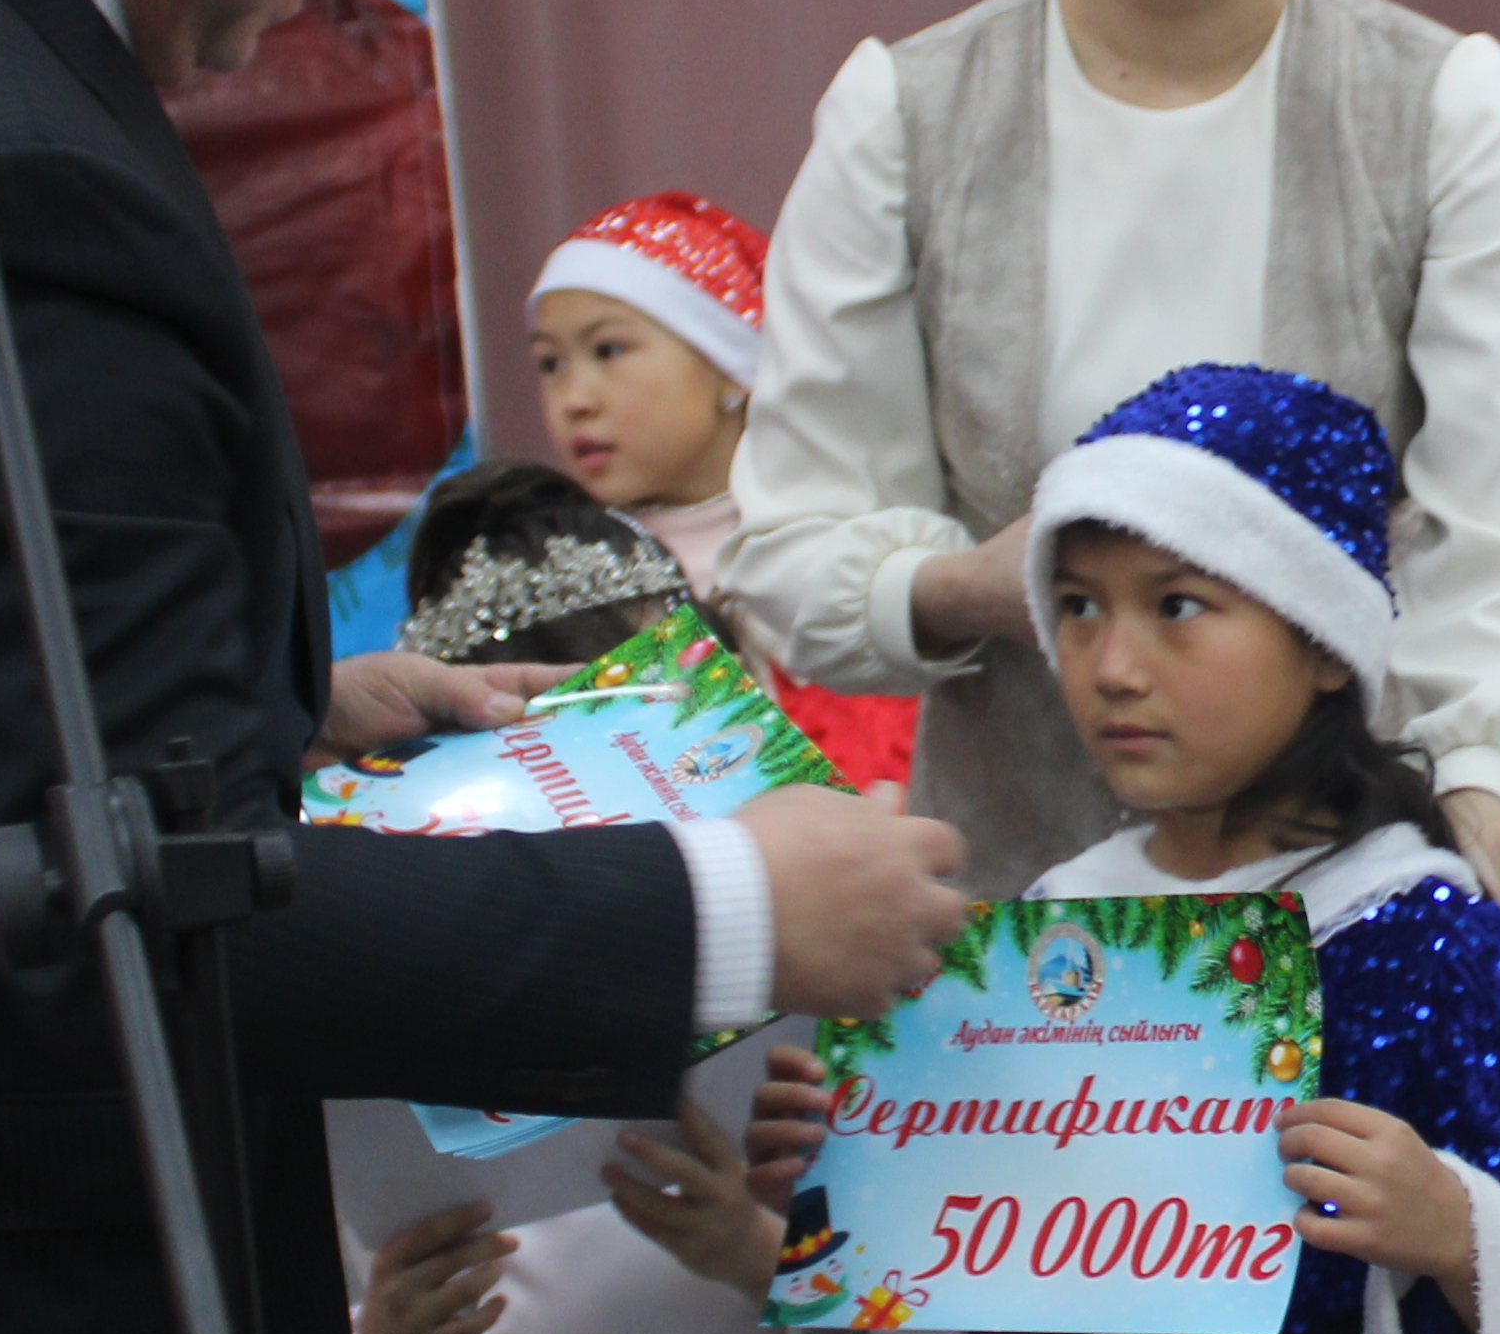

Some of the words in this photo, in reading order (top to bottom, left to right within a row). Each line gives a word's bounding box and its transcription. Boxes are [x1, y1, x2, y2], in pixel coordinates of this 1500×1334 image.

[949, 1018, 1016, 1053] Аудан
[1017, 1018, 1105, 1047] әкімінің
[1107, 1019, 1202, 1043] сыйлығы
[825, 1073, 1296, 1151] Сертификат
[909, 1193, 1021, 1282] 50
[1028, 1194, 1295, 1283] 000тг
